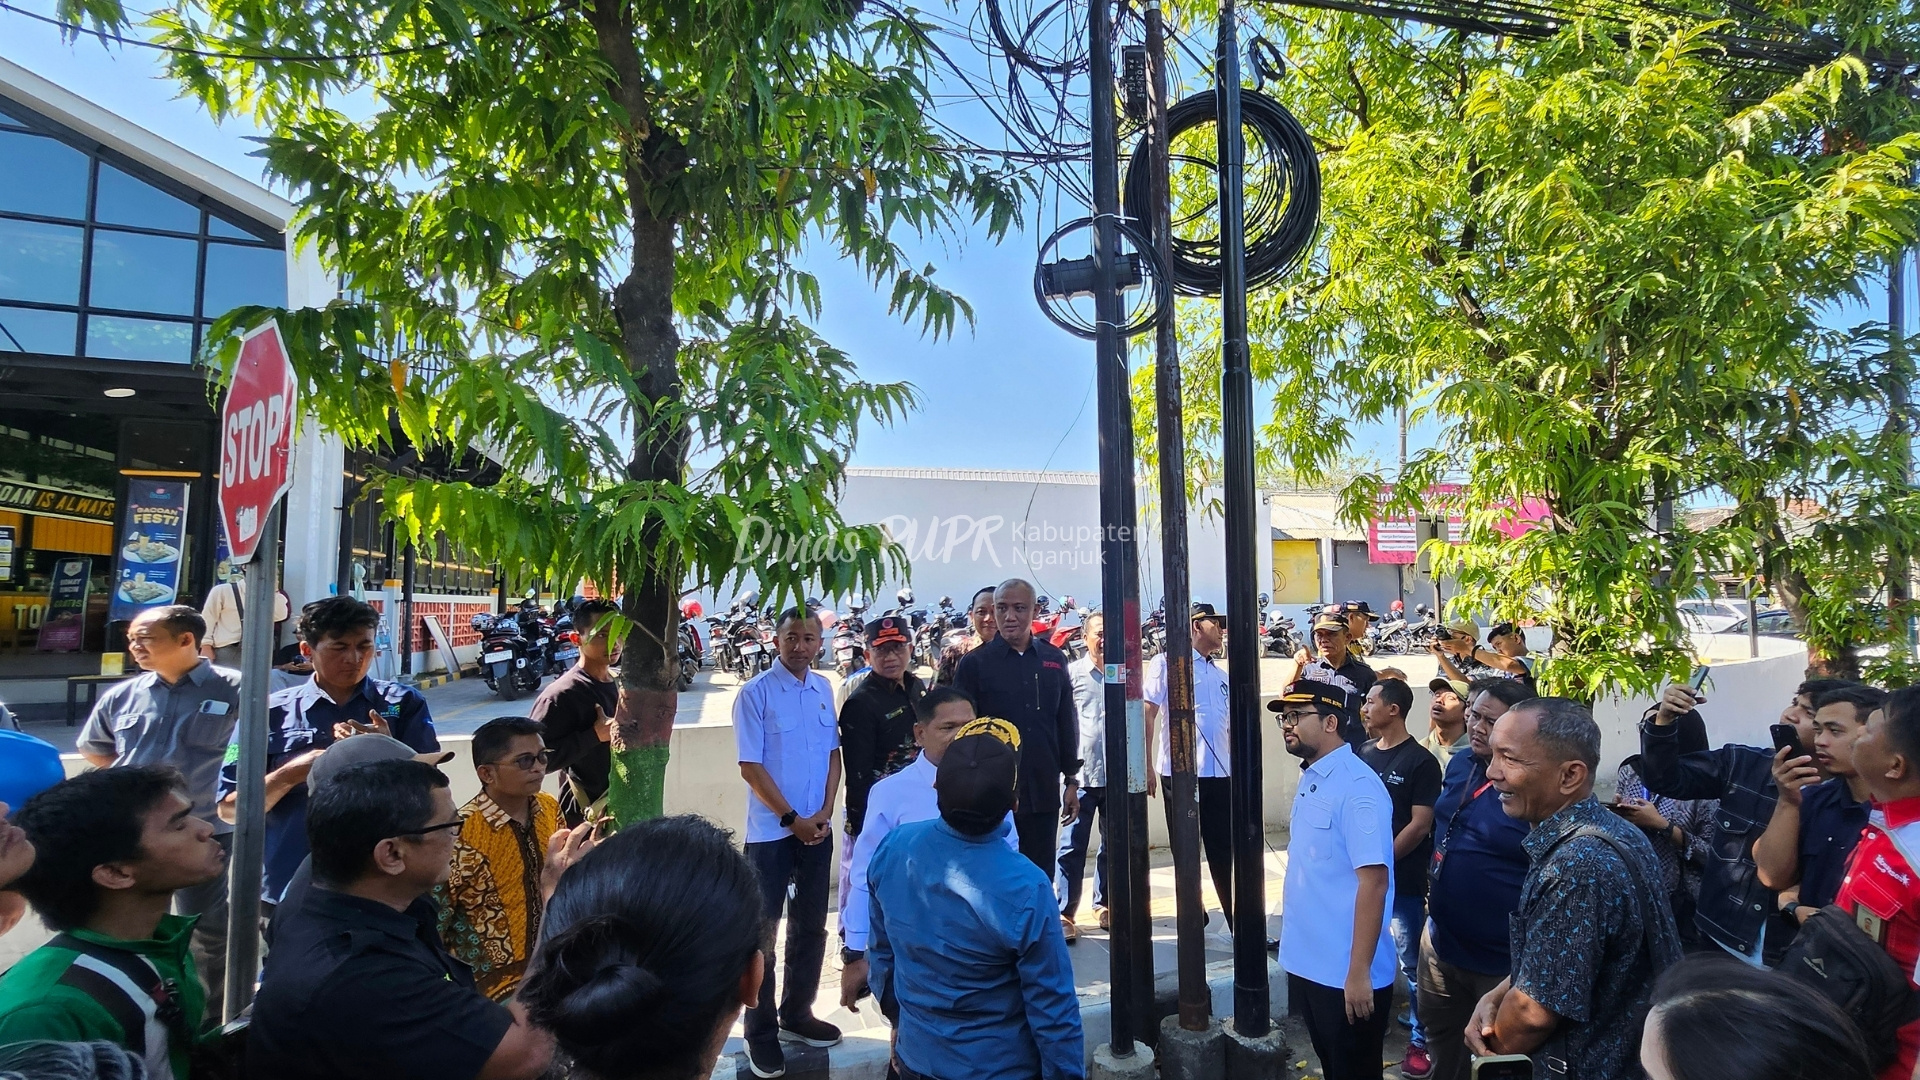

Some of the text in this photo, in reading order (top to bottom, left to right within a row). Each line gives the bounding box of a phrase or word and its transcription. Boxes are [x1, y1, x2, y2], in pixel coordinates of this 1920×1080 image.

[225, 395, 283, 488] STOP
[0, 484, 115, 517] OAN IS ALWAYS
[133, 513, 180, 526] FEST!
[122, 568, 130, 578] C
